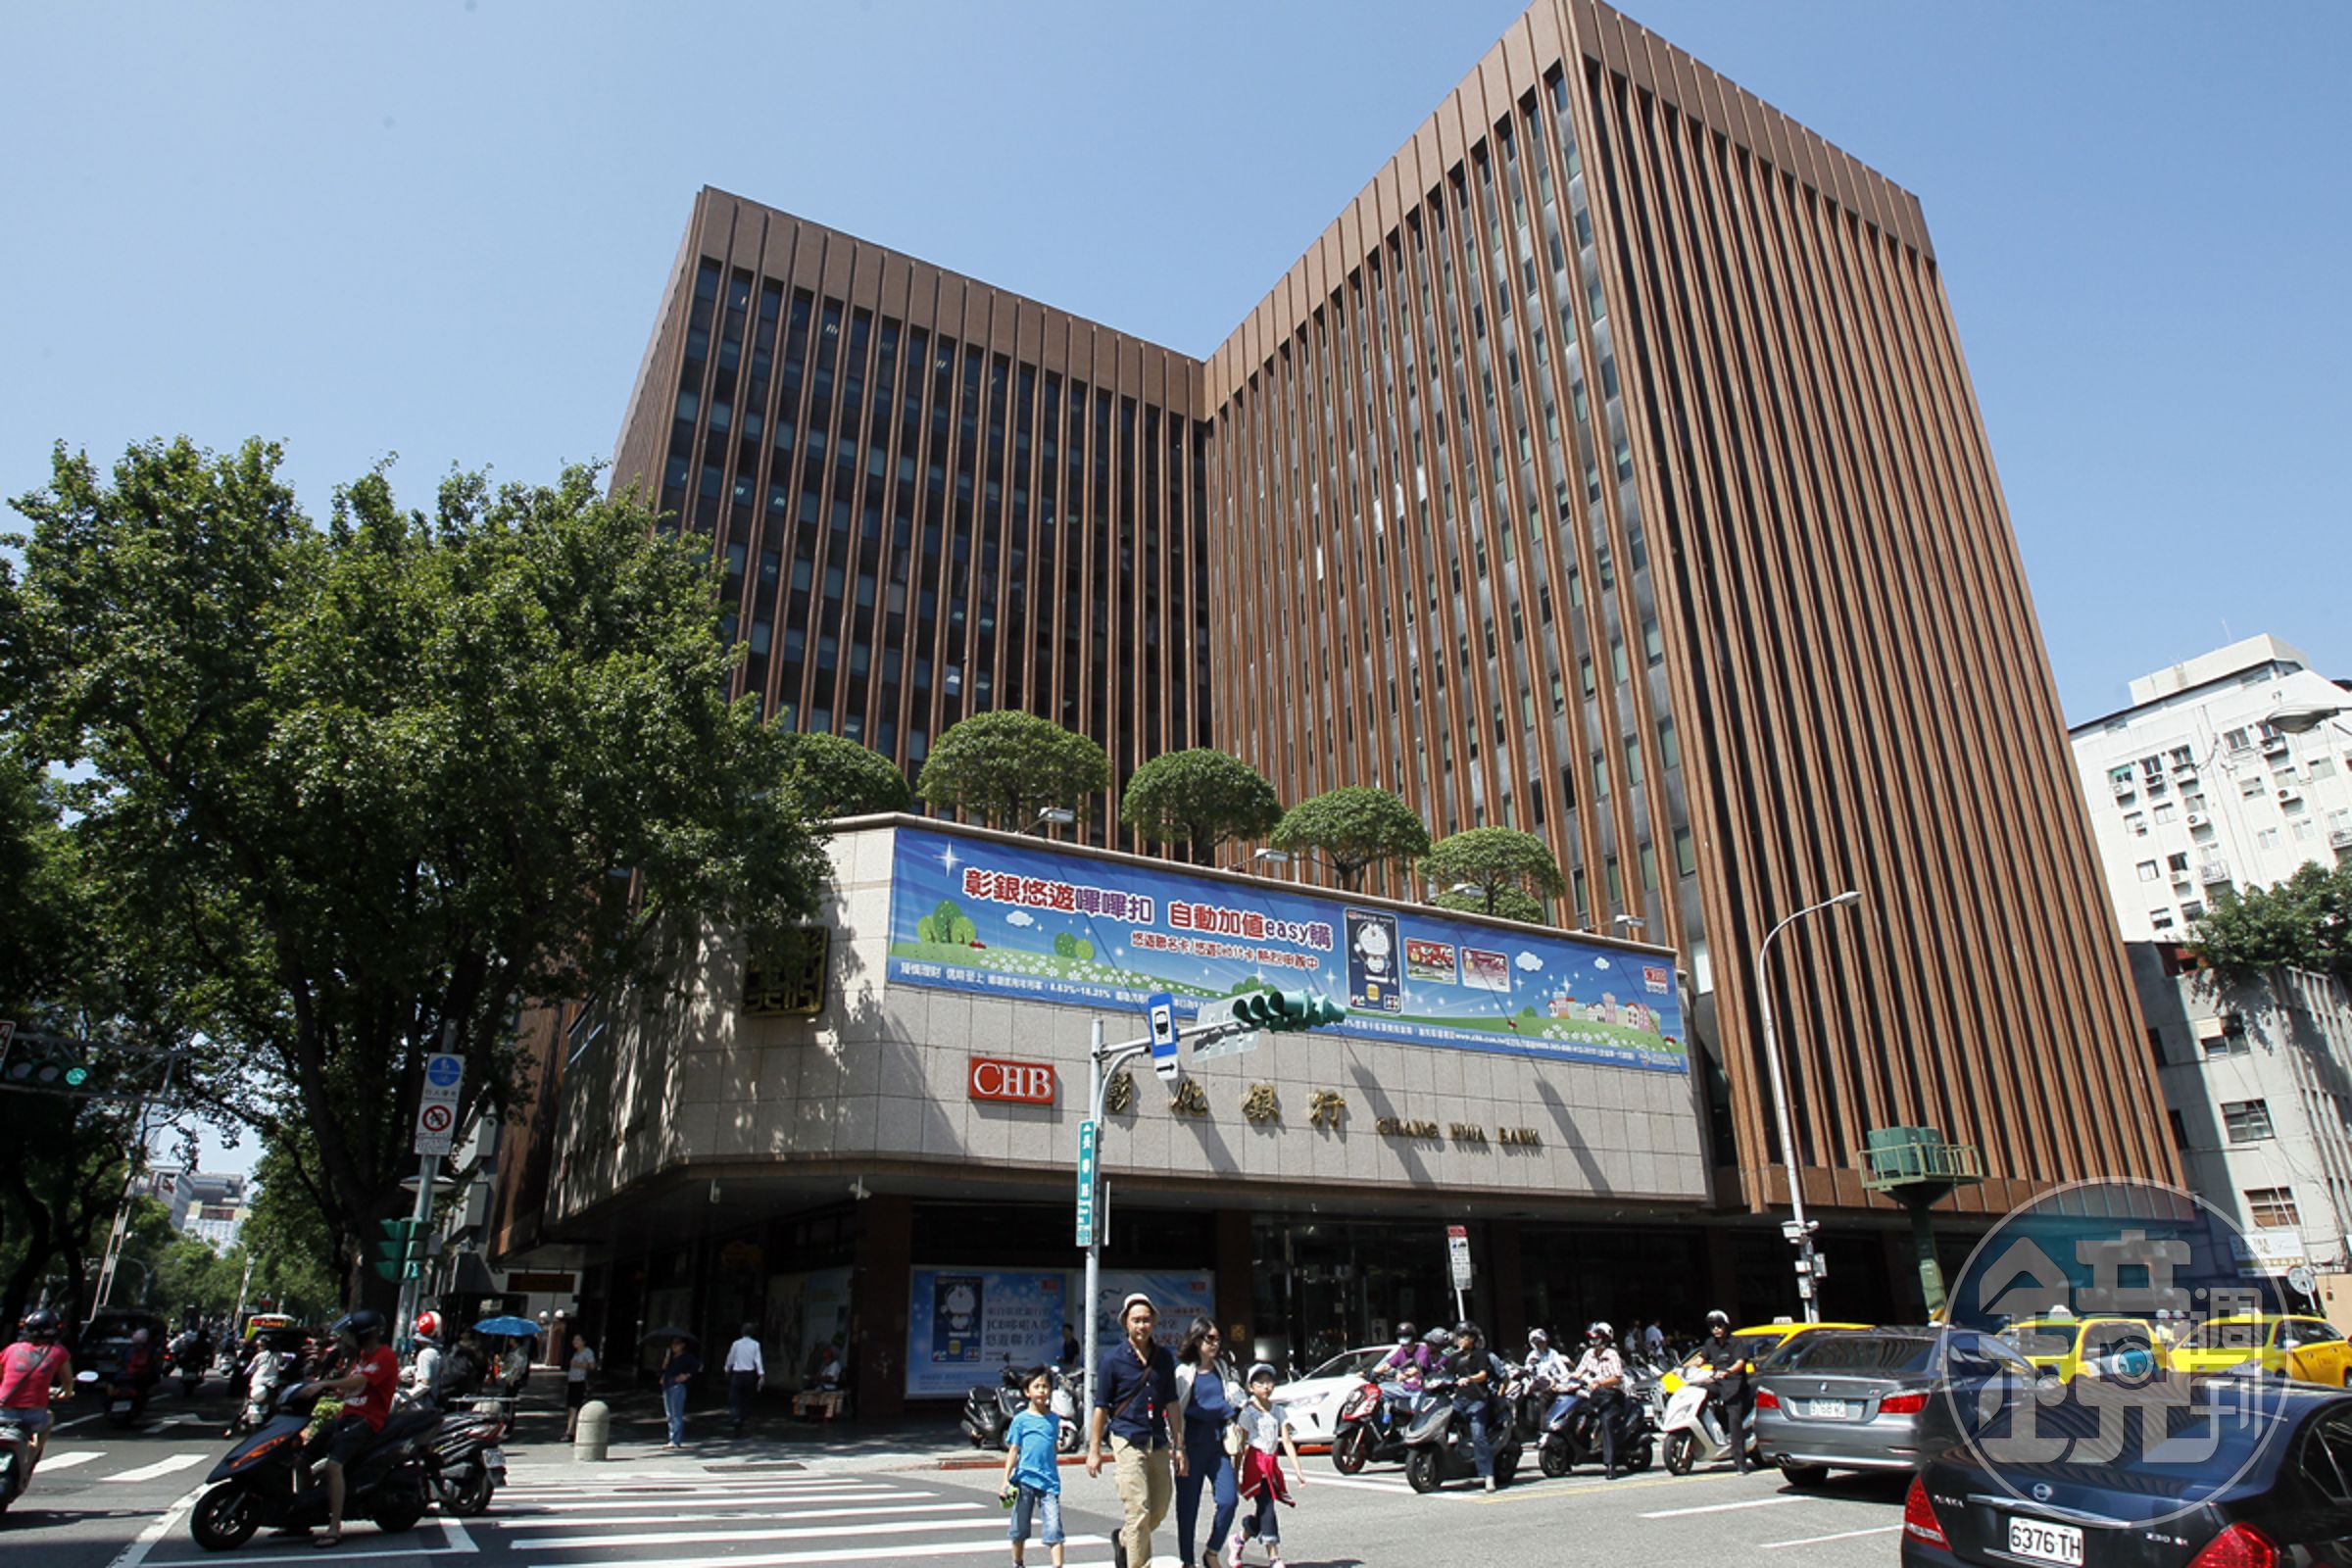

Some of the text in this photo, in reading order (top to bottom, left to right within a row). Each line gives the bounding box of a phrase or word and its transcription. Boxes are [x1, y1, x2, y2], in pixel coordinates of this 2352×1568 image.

[964, 869, 1333, 950] 彰銀悠遊嗶嗶扣 自動加值easy購
[973, 1061, 1053, 1099] CHB
[1375, 1116, 1440, 1139] CHANG
[1496, 1127, 1540, 1146] BANK
